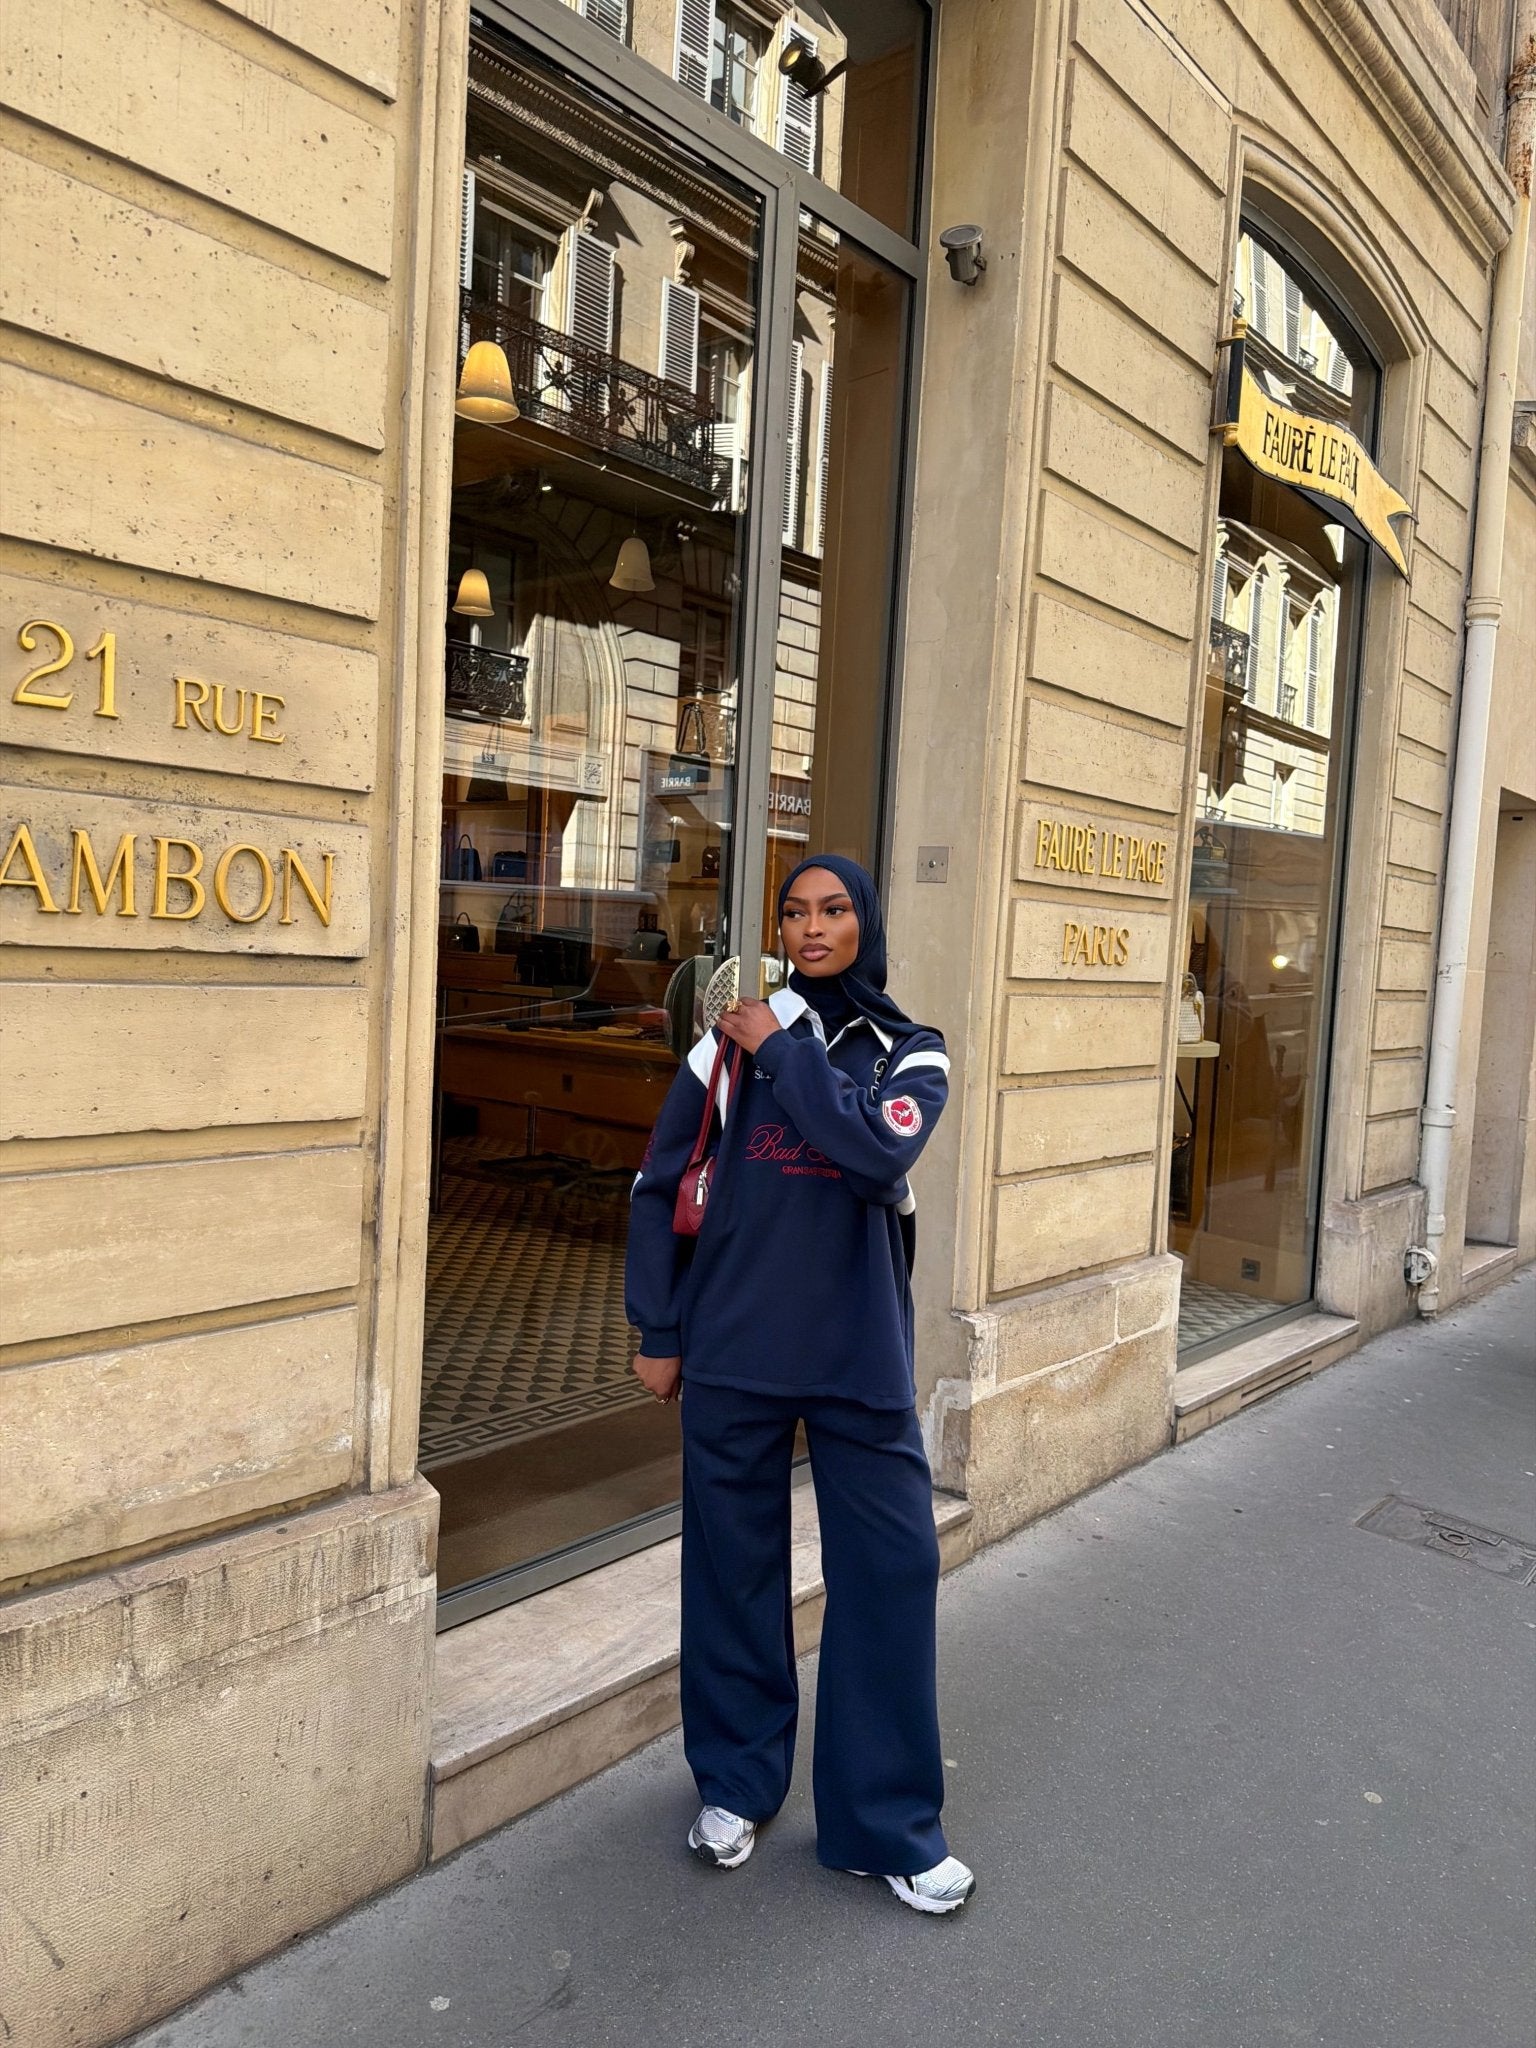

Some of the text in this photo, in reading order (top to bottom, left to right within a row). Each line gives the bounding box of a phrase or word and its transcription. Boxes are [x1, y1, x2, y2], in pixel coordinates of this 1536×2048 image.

[1319, 435, 1338, 480] LE
[1338, 443, 1360, 497] PA
[12, 620, 287, 745] 21 RUE
[1099, 832, 1125, 878] LE
[1125, 836, 1168, 884] PAGE
[1062, 921, 1130, 966] PARIS
[745, 1124, 808, 1161] Bad
